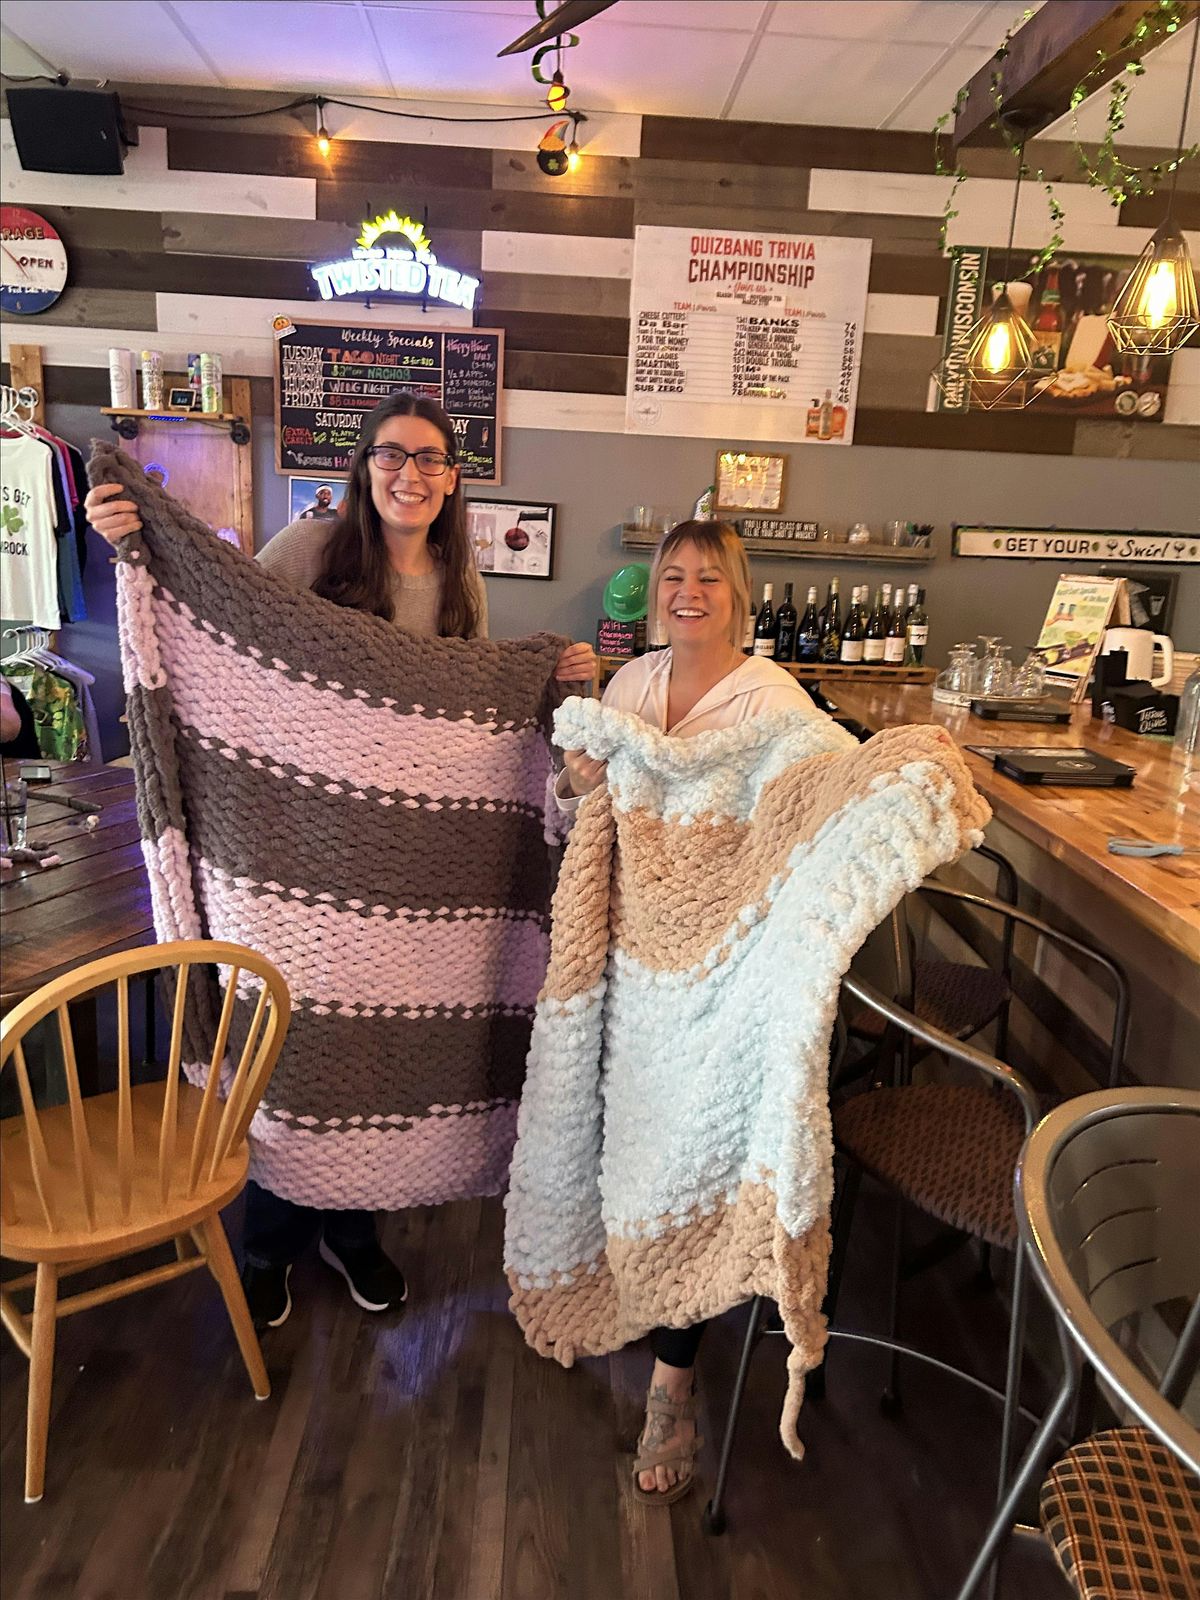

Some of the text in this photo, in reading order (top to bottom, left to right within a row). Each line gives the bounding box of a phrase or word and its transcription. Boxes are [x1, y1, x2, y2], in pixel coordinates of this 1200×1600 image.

[691, 236, 816, 260] QUIZBANG TRIVIA
[19, 256, 54, 269] OPEN
[311, 259, 427, 300] TWISTED
[688, 258, 815, 289] CHAMPIONSHIP
[952, 252, 982, 343] WISCONSIN
[673, 302, 692, 312] TEAM
[784, 308, 801, 318] TEAM
[638, 319, 689, 329] Da Bar
[640, 311, 686, 321] CHEESE CUTTERS
[749, 317, 800, 327] BANKS
[341, 329, 434, 349] Weekly Specials
[668, 336, 690, 346] MONEY
[282, 345, 324, 362] TUESDAY
[327, 348, 375, 364] TACO
[375, 352, 400, 366] NIGHT
[446, 339, 491, 357] Happy Hour
[657, 352, 679, 360] LADIES
[746, 357, 798, 368] DOUBLE TROUBLE
[367, 367, 411, 380] NACHOS
[282, 376, 325, 393] THURSDAY
[328, 381, 361, 393] WING
[363, 382, 392, 394] NIGHT
[634, 384, 684, 393] SUB ZERO
[282, 391, 325, 409] FRIDAY
[315, 412, 363, 429] SATURDAY
[13, 488, 31, 508] GET
[1006, 537, 1168, 558] GET YOUR Swirl
